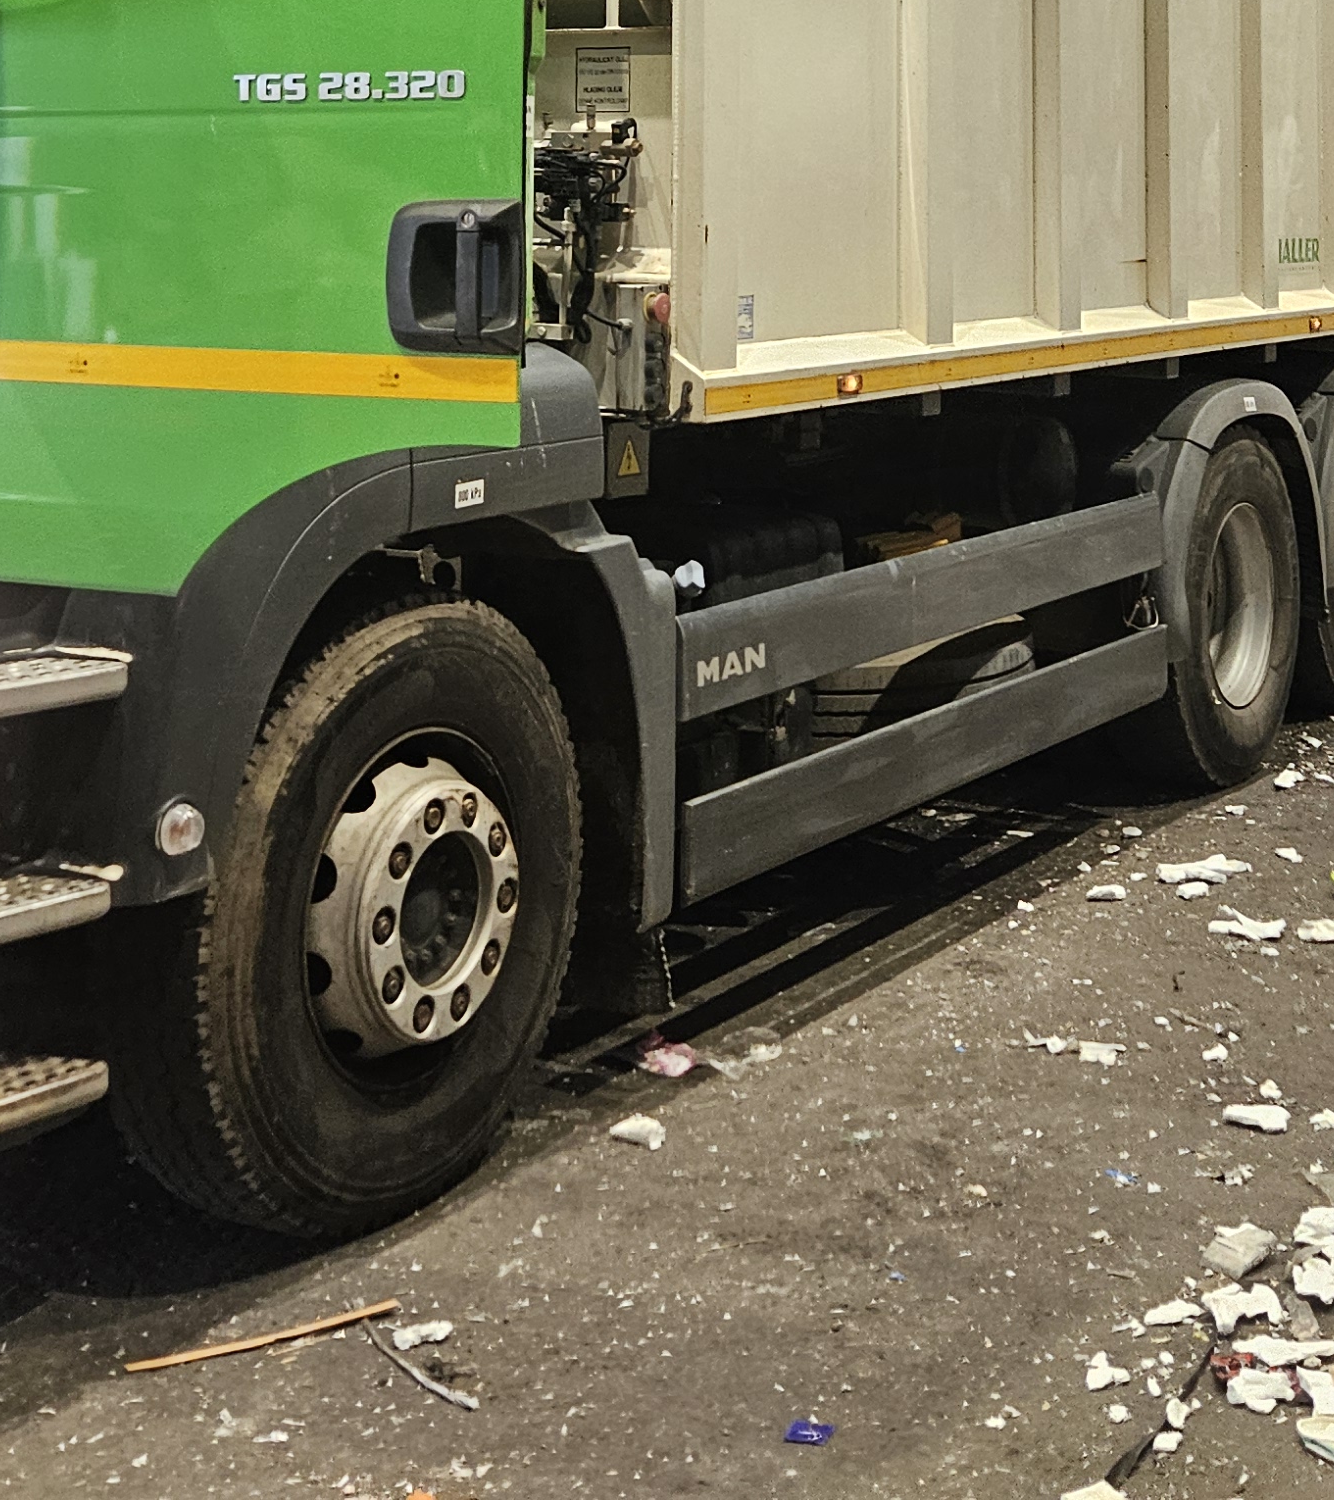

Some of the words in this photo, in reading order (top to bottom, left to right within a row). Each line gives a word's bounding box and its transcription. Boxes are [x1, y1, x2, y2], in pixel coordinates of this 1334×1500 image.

[233, 73, 307, 102] TGS
[318, 69, 465, 100] 28.320
[696, 642, 766, 688] MAN
